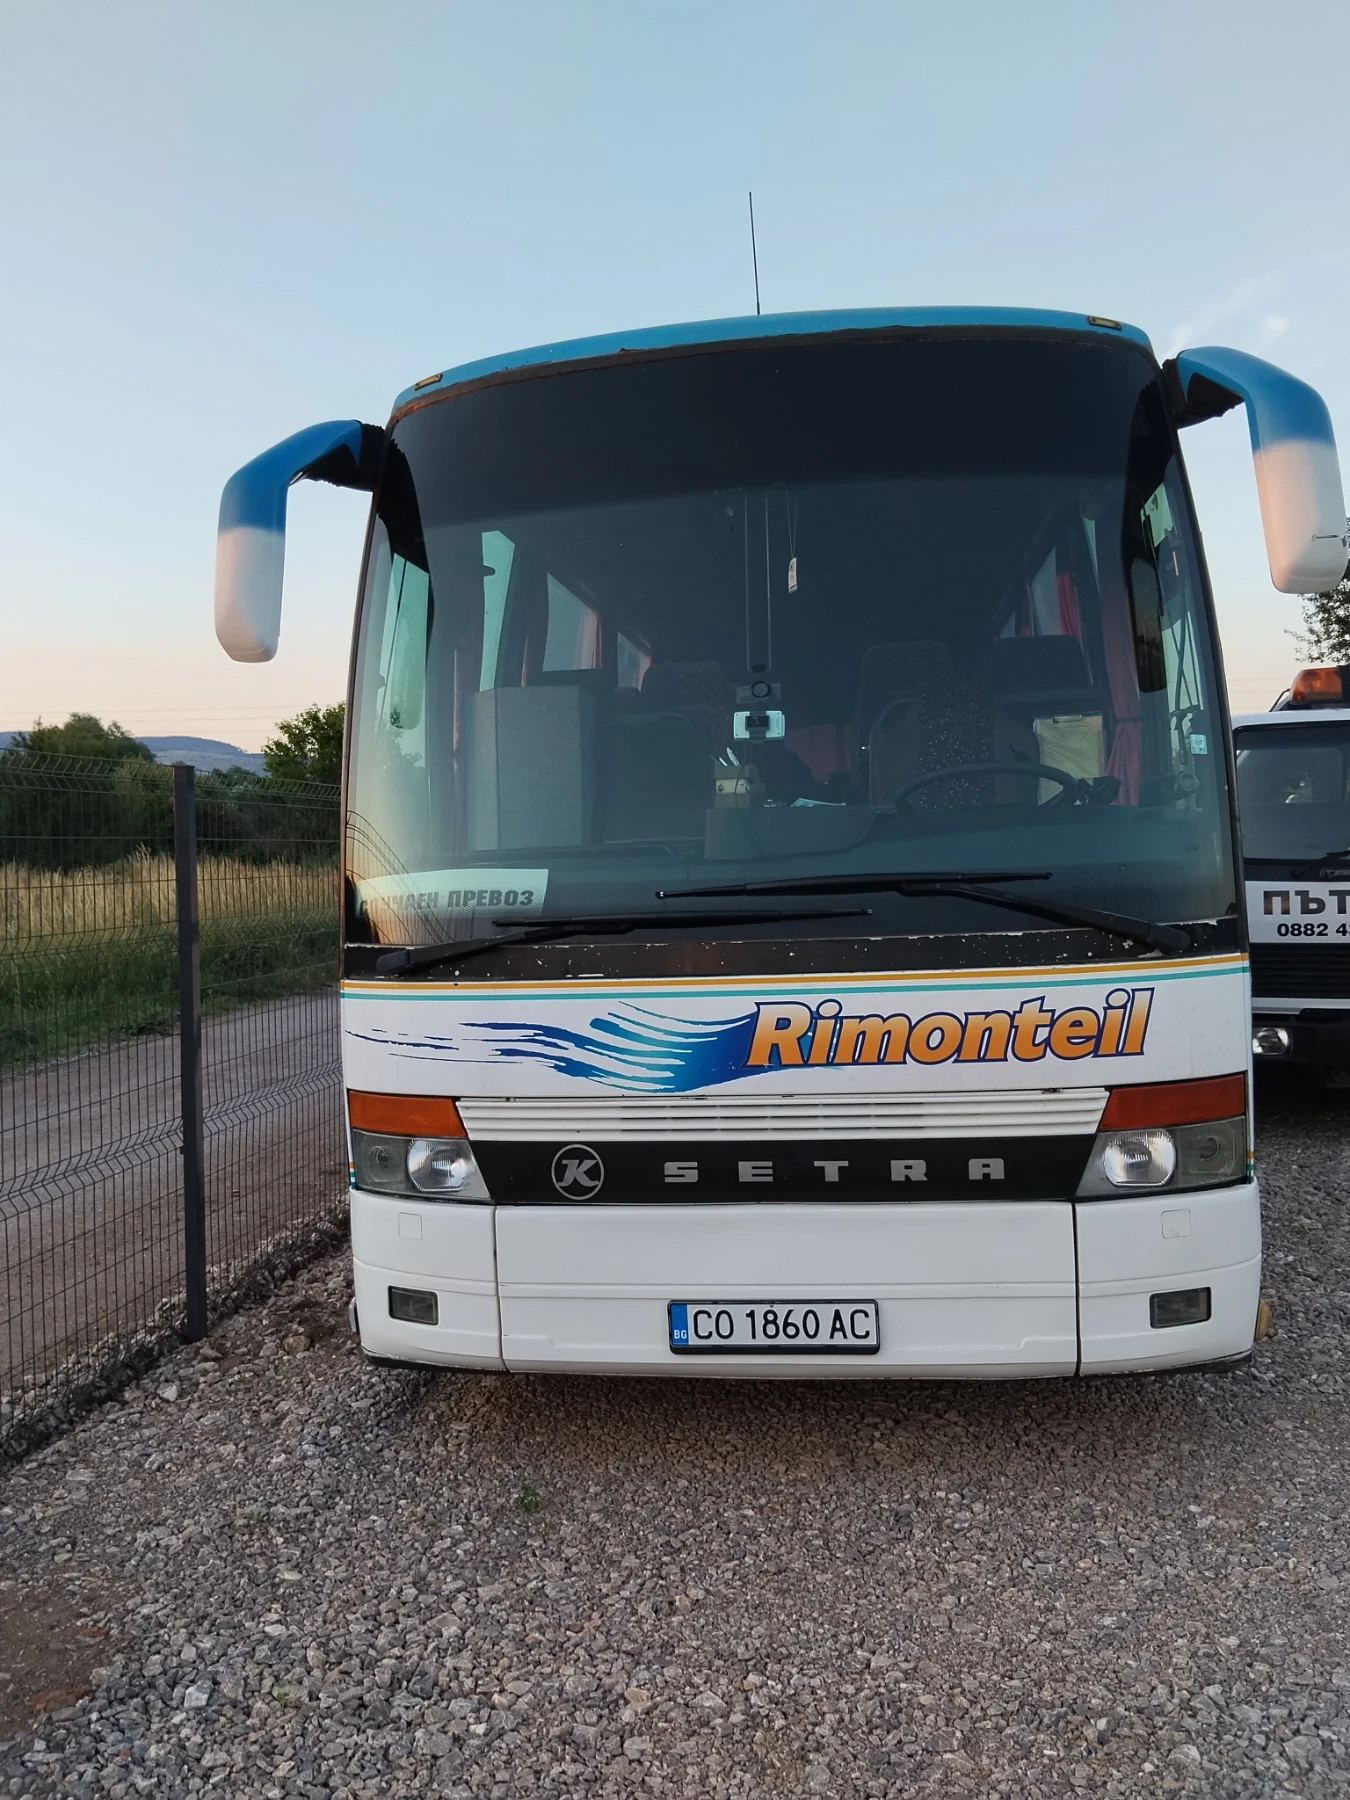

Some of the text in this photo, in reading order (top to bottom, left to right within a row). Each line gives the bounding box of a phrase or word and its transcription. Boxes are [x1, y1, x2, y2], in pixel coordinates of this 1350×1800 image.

[448, 889, 534, 908] ПРЕВОЗ
[1277, 923, 1350, 937] 0882 4
[744, 987, 1155, 1067] Rimonteil
[664, 1158, 1005, 1182] SETRA
[673, 1329, 687, 1339] BG
[693, 1308, 870, 1339] CO 1860 AC
